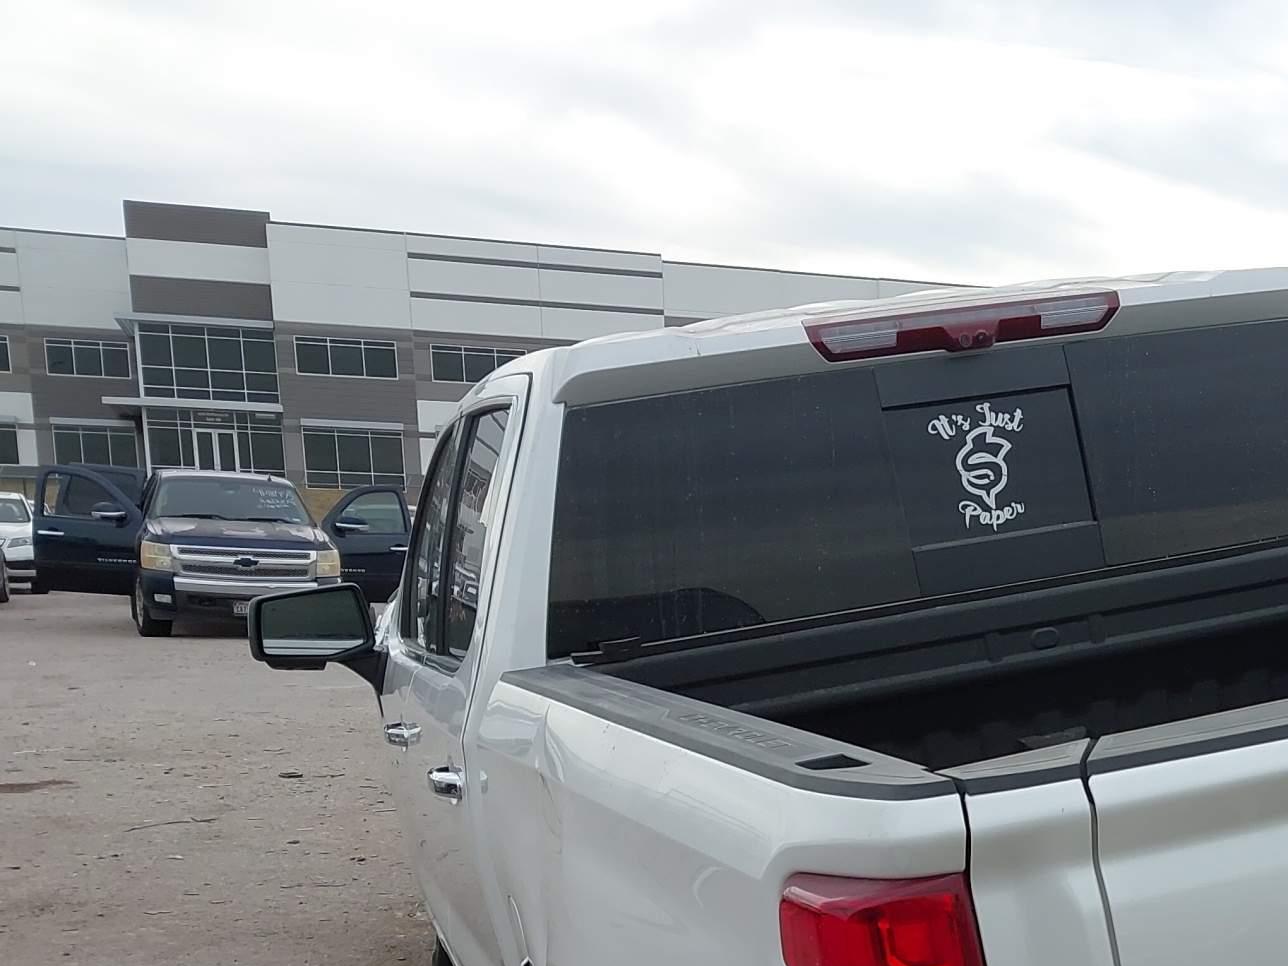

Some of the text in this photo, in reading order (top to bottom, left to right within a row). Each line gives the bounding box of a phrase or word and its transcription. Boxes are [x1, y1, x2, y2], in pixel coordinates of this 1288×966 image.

[927, 402, 1024, 440] It's Just
[958, 500, 1025, 531] Paper
